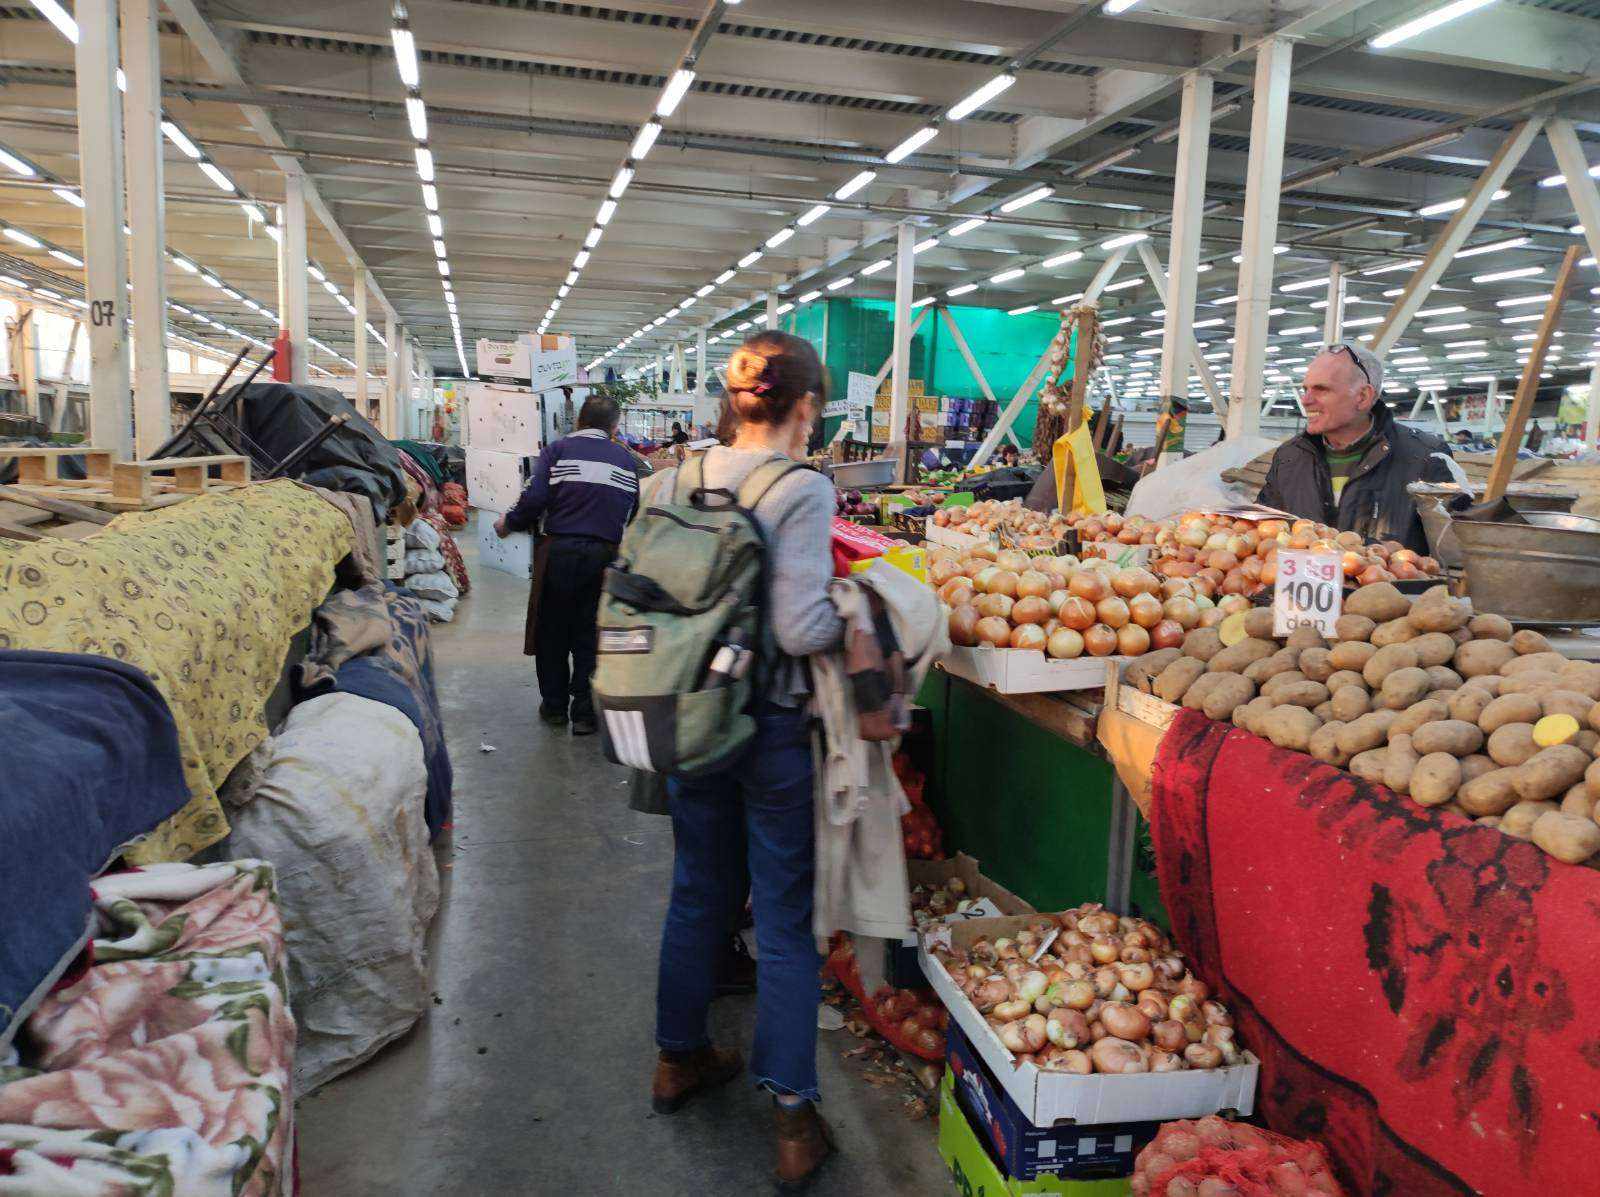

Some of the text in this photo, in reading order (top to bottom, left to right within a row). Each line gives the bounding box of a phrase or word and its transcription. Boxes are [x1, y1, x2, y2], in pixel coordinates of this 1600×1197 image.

[91, 300, 115, 326] 07
[1283, 559, 1297, 576] 3
[1281, 582, 1334, 613] 100
